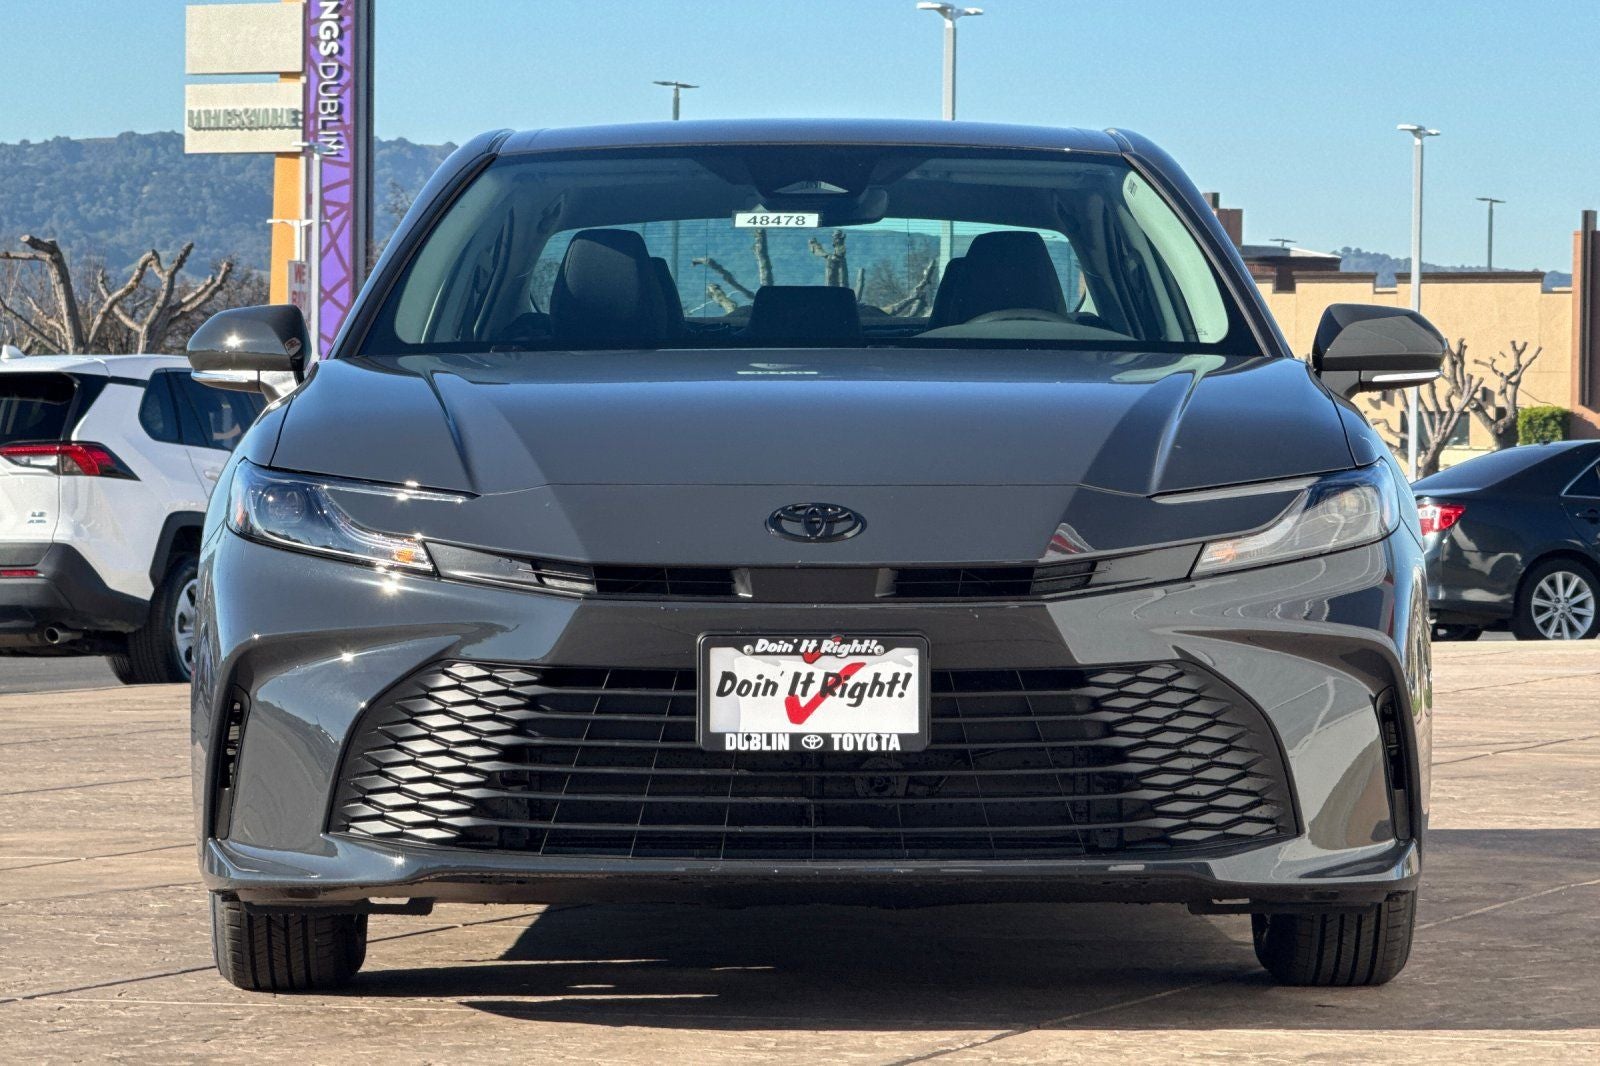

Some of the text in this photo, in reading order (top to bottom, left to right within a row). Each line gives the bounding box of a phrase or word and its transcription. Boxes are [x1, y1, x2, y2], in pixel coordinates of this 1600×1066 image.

[318, 62, 344, 156] DUBLIN
[746, 215, 806, 226] 48478
[755, 638, 878, 658] Doin' It Right!
[715, 670, 913, 708] Doin' It Right!
[725, 733, 901, 751] DUBLIN TOYOTA
